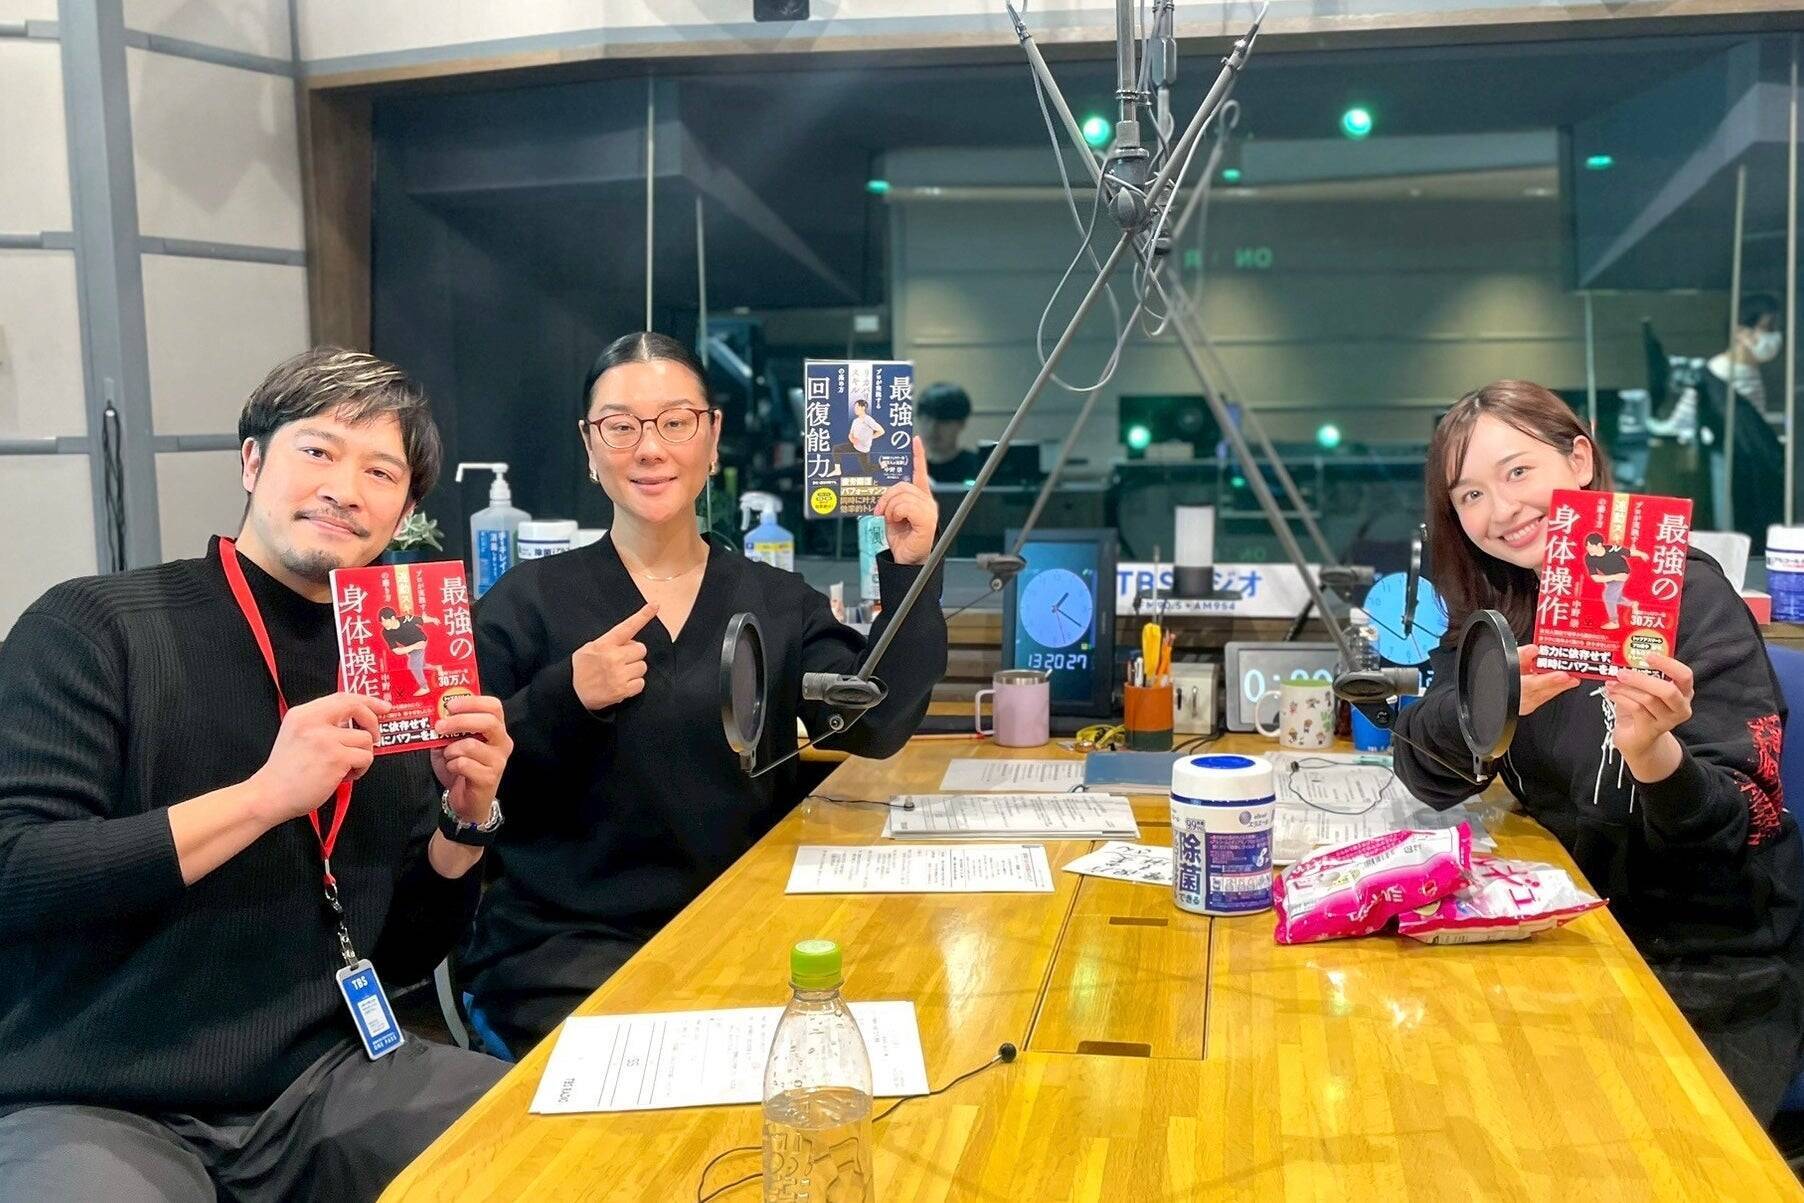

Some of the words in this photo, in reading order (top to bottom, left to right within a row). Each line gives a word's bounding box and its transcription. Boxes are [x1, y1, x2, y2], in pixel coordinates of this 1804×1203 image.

[807, 377, 831, 478] 回復能力
[889, 376, 913, 450] 最強の
[1117, 570, 1263, 598] TBSジオ
[1538, 504, 1581, 626] 身体操作
[1652, 514, 1688, 601] 最強の
[440, 576, 473, 660] 最強の
[1193, 600, 1236, 611] AM954
[1630, 616, 1666, 628] 30万人
[339, 584, 380, 697] 身体操作
[438, 675, 470, 686] 30万人
[1179, 832, 1201, 894] 除菌
[1178, 894, 1201, 905] できる
[351, 975, 369, 990] TBS
